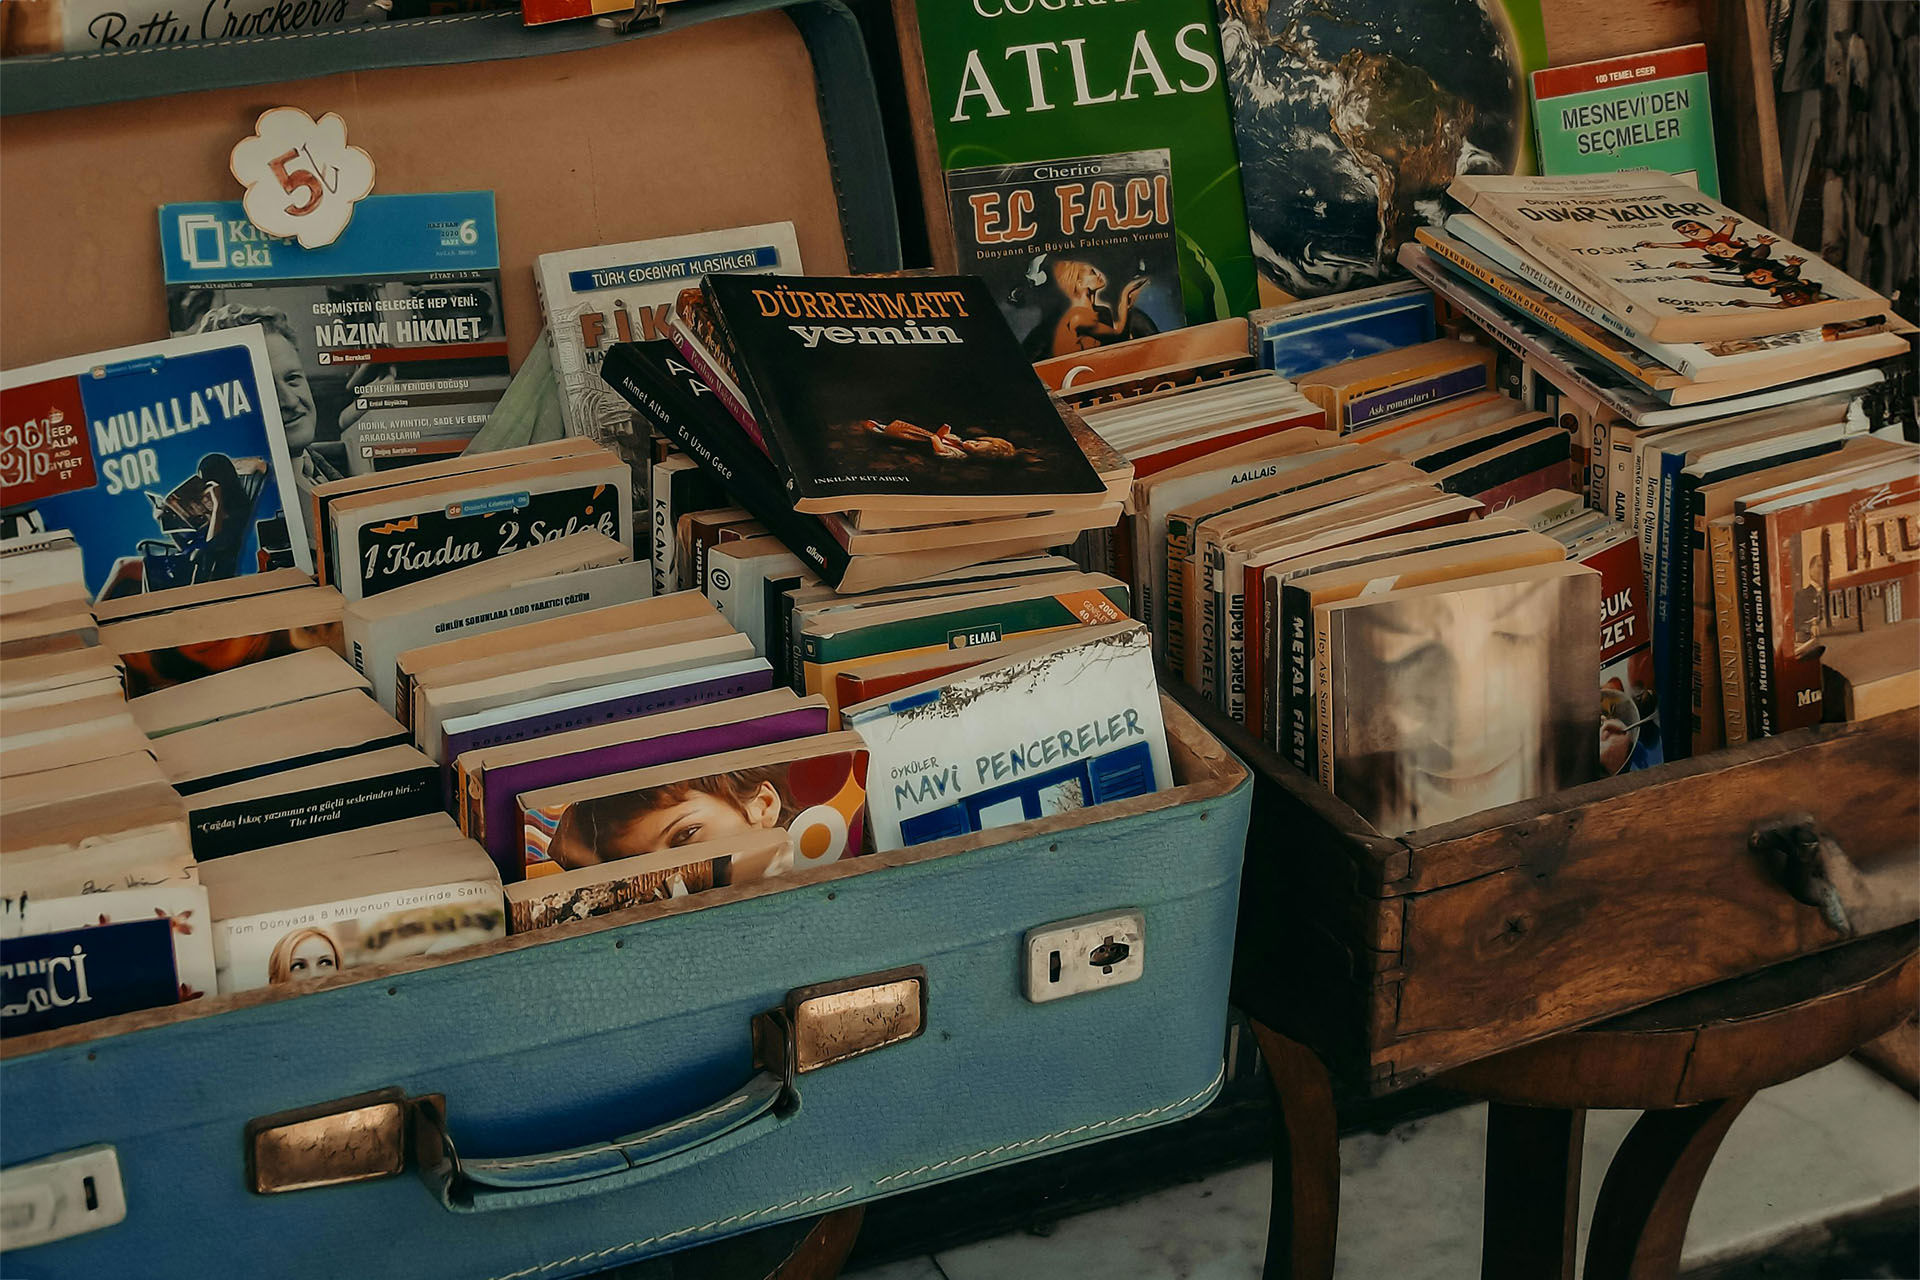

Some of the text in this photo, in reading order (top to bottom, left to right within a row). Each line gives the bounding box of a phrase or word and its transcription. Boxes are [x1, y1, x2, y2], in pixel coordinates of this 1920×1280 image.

[949, 23, 1217, 122] ATLAS
[1609, 70, 1634, 81] TEMEL
[1635, 66, 1656, 77] ESER
[1562, 89, 1690, 130] MESNEVİ'DEN
[1578, 118, 1680, 157] SEÇMELER
[1033, 164, 1101, 180] Cheriro
[1517, 206, 1602, 224] DUVAR
[1600, 202, 1717, 224] YAZILARI
[460, 220, 478, 245] 6
[976, 247, 1024, 259] Dünyanın
[1028, 245, 1041, 254] En
[1045, 240, 1076, 252] Büyük
[1133, 231, 1169, 243] Yorumu
[230, 246, 272, 268] eki
[1570, 246, 1638, 257] TOSUN
[592, 251, 757, 288] TÜRK EDEBİYAT KLASİKLERİ
[312, 298, 372, 317] GEÇMİŞTEN
[375, 294, 425, 311] GELECEĞE
[427, 297, 448, 310] HEP
[752, 284, 970, 321] DÜRRENMATT
[1564, 290, 1597, 316] DANTEL
[315, 314, 481, 348] NÂZIM HİKMET
[789, 319, 964, 348] yemin
[93, 379, 251, 457] MUALLA'YA
[1386, 390, 1431, 412] romanları
[52, 425, 73, 438] EEP
[433, 415, 453, 426] SADE
[455, 414, 466, 425] VE
[622, 375, 733, 481] Ahmet Altan En Uzun Gece
[52, 436, 78, 449] ALM
[1594, 423, 1607, 457] Can
[60, 470, 73, 480] ET
[102, 448, 160, 495] SOR
[1231, 465, 1277, 486] A.ALLAIS
[1615, 490, 1626, 522] ALAIN
[1646, 476, 1658, 511] Benim
[364, 508, 616, 580] 1 Kadın 2 Salak
[655, 498, 667, 562] KOCAN
[695, 537, 704, 590] tatürk
[1750, 530, 1762, 587] Atatürk
[436, 614, 464, 633] GÜNLÜK
[465, 607, 508, 627] SORUNLARA
[531, 599, 563, 612] YARATICI
[563, 592, 590, 609] ÇÖZÜM
[1098, 601, 1118, 620] 2008
[1229, 594, 1244, 640] kadın
[1754, 591, 1765, 634] Kemal
[969, 631, 997, 646] ELMA
[1201, 599, 1214, 701] MICHAELS
[1600, 616, 1635, 651] ZET
[1229, 643, 1244, 690] paket
[1291, 616, 1305, 697] METAL
[1757, 637, 1768, 692] Mustafa
[1318, 631, 1329, 719] Hey Seni
[890, 755, 940, 781] ÖYKÜLER
[894, 707, 1146, 812] MAVİ PENCERELER
[264, 806, 304, 824] yazınının
[306, 805, 318, 815] en
[319, 797, 345, 815] güçlü
[346, 788, 393, 807] seslerinden
[289, 810, 341, 829] The Herald
[226, 922, 255, 936] Tüm
[259, 912, 316, 934] Dünyada
[333, 899, 392, 920] Milyonun
[396, 888, 453, 908] Üzerinde
